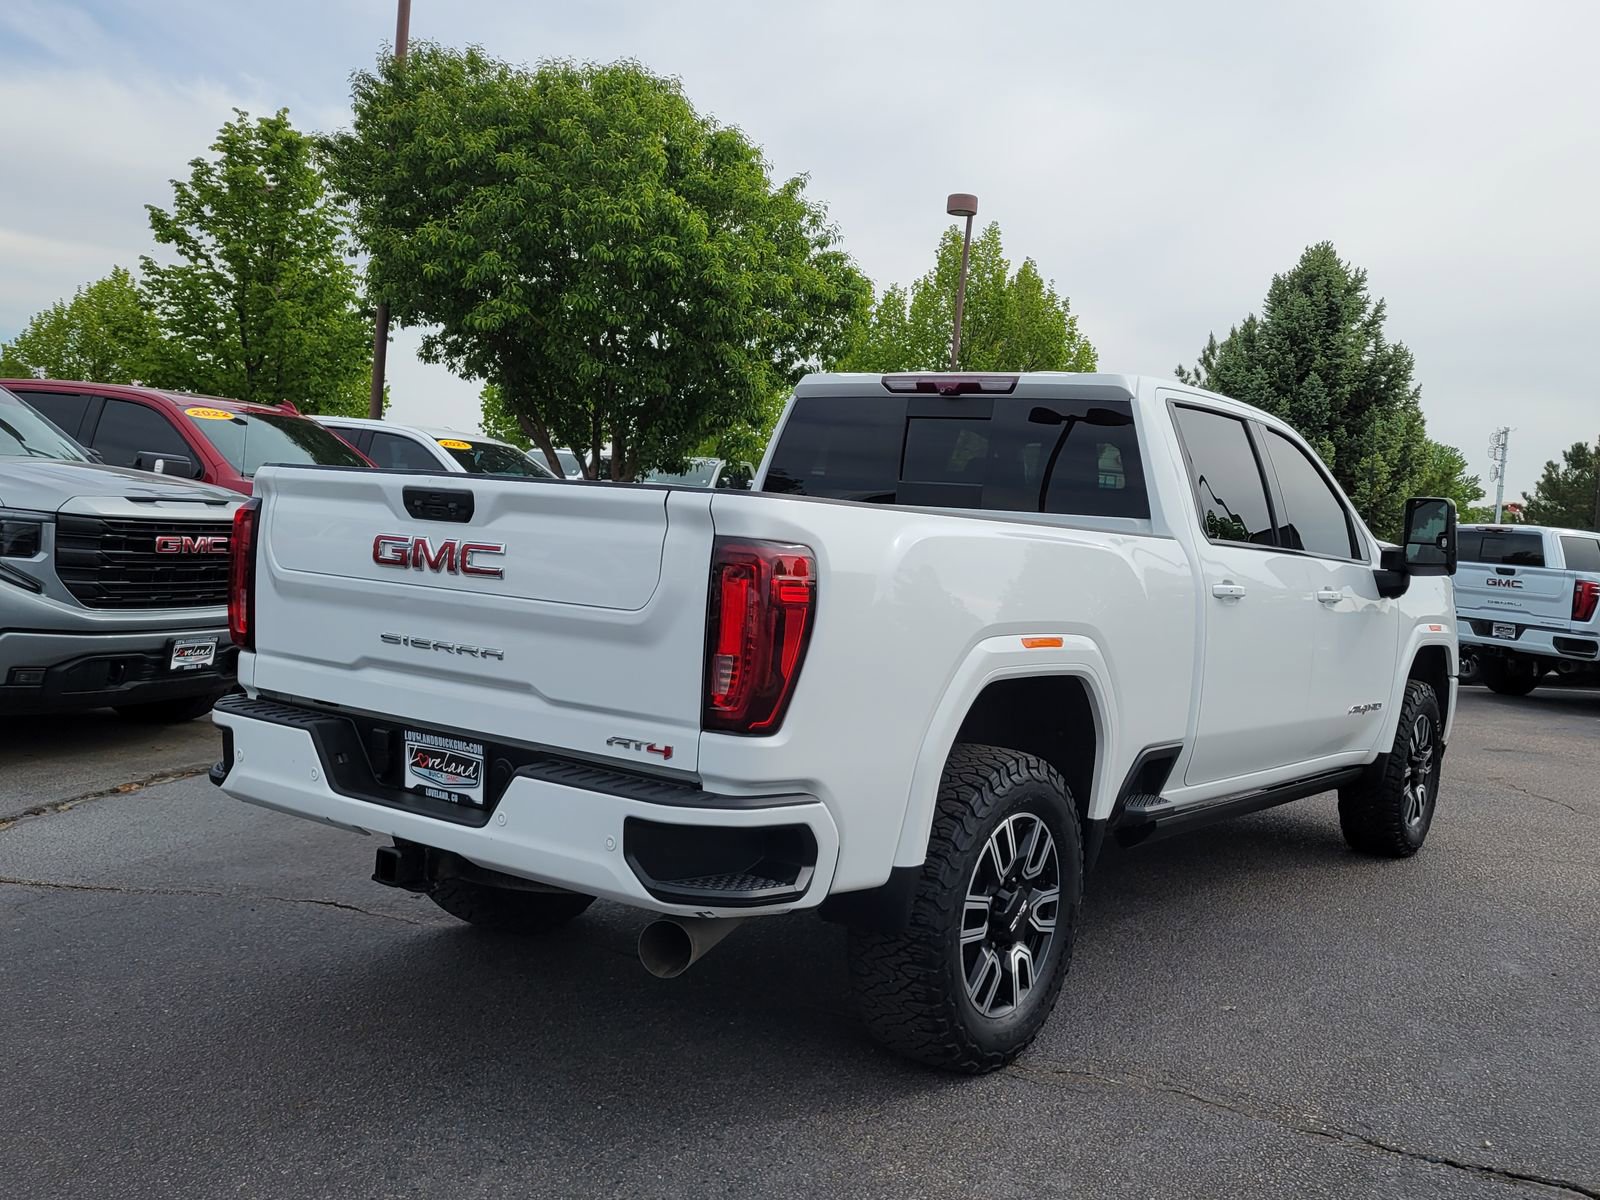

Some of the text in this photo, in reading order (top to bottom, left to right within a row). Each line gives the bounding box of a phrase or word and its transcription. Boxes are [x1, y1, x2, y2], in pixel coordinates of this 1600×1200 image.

[191, 409, 230, 418] 2022
[155, 536, 228, 554] GMC
[372, 533, 507, 580] GMC
[1486, 578, 1523, 589] GMC
[380, 631, 505, 661] SIERRA
[404, 730, 484, 755] LOVELANDBUICKGMC.COM
[606, 736, 674, 761] AT4
[409, 745, 478, 778] Loveland
